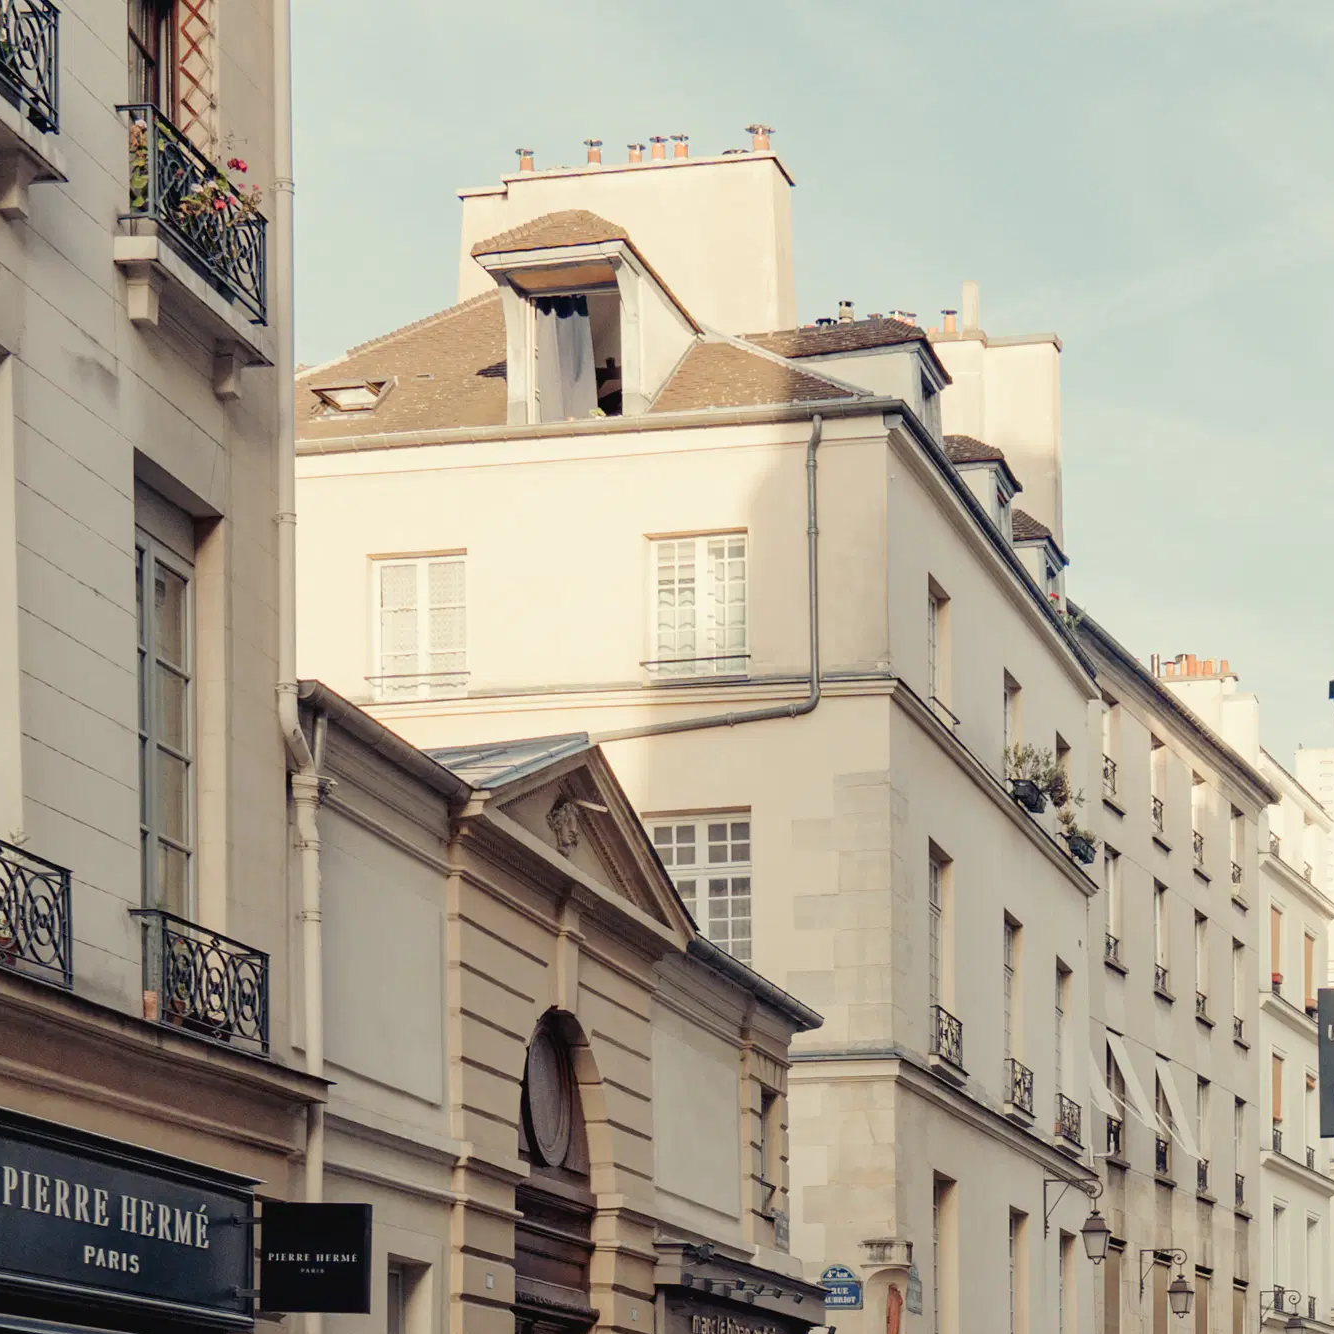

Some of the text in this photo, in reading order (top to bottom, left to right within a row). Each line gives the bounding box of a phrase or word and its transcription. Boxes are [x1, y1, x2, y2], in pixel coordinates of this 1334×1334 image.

[1, 1165, 211, 1250] PIERRE HERMÉ
[83, 1244, 141, 1275] PARIS
[267, 1251, 359, 1264] PIERRE HERMÉ
[300, 1267, 326, 1275] PARIS
[831, 1287, 849, 1295] RUE
